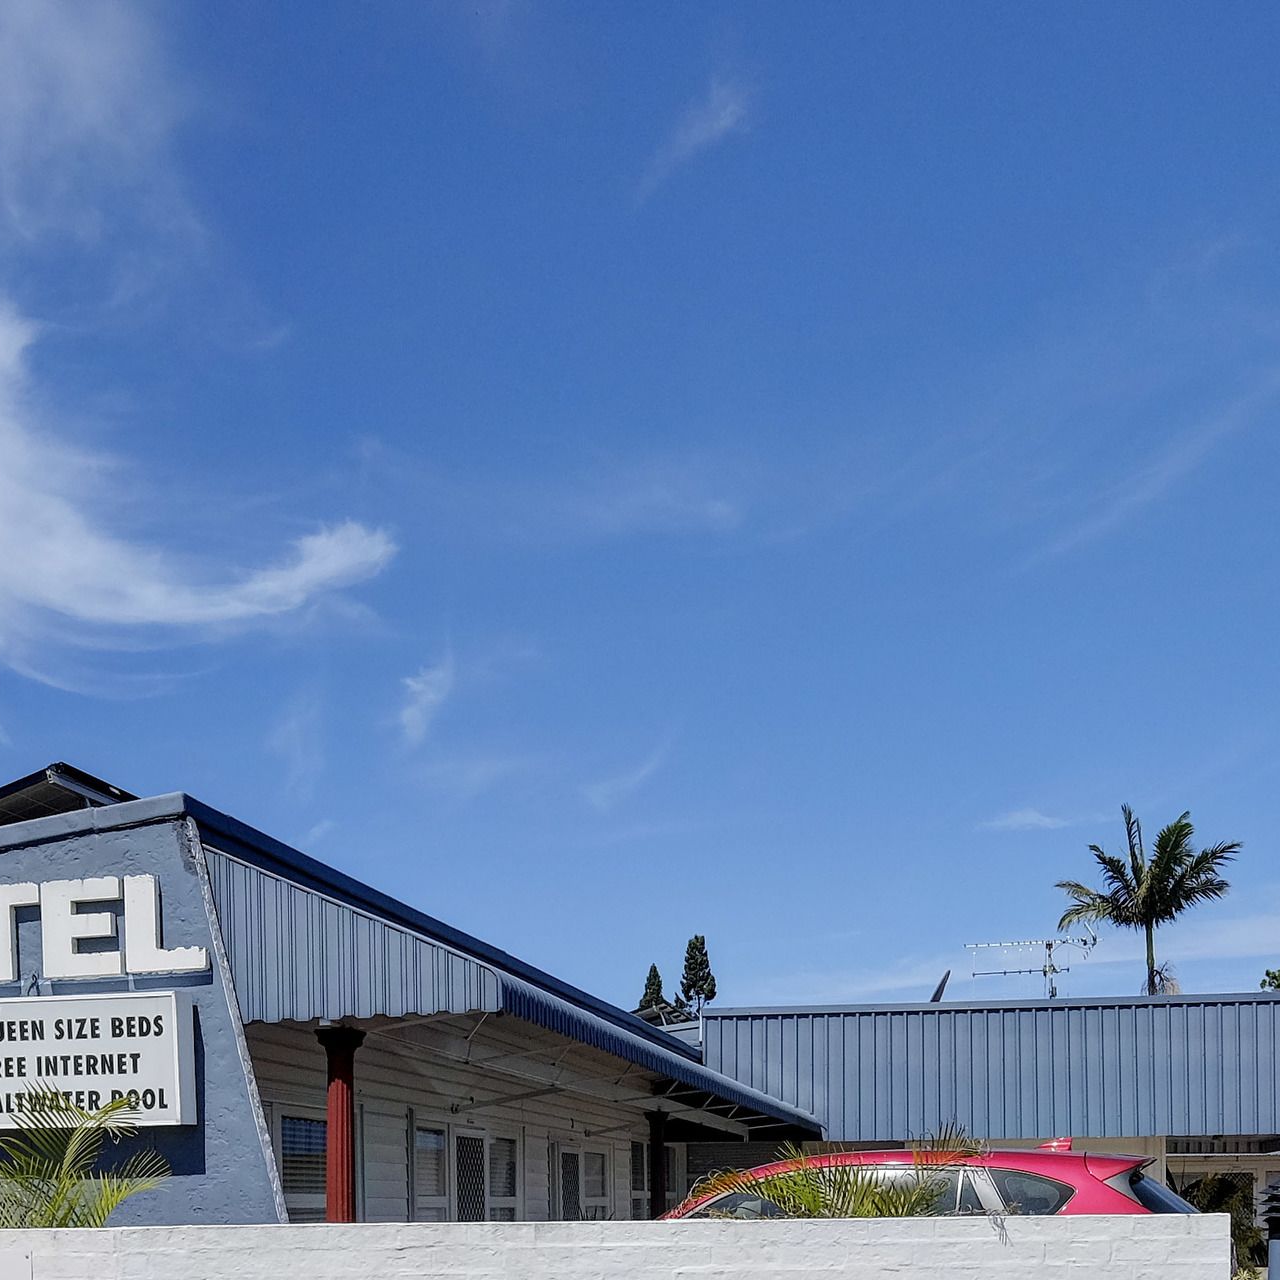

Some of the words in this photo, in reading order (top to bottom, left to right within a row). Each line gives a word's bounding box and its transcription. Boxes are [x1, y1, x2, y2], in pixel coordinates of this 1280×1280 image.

[54, 1017, 101, 1040] SIZE
[111, 1015, 164, 1038] BEDS
[36, 1053, 141, 1077] INTERNET
